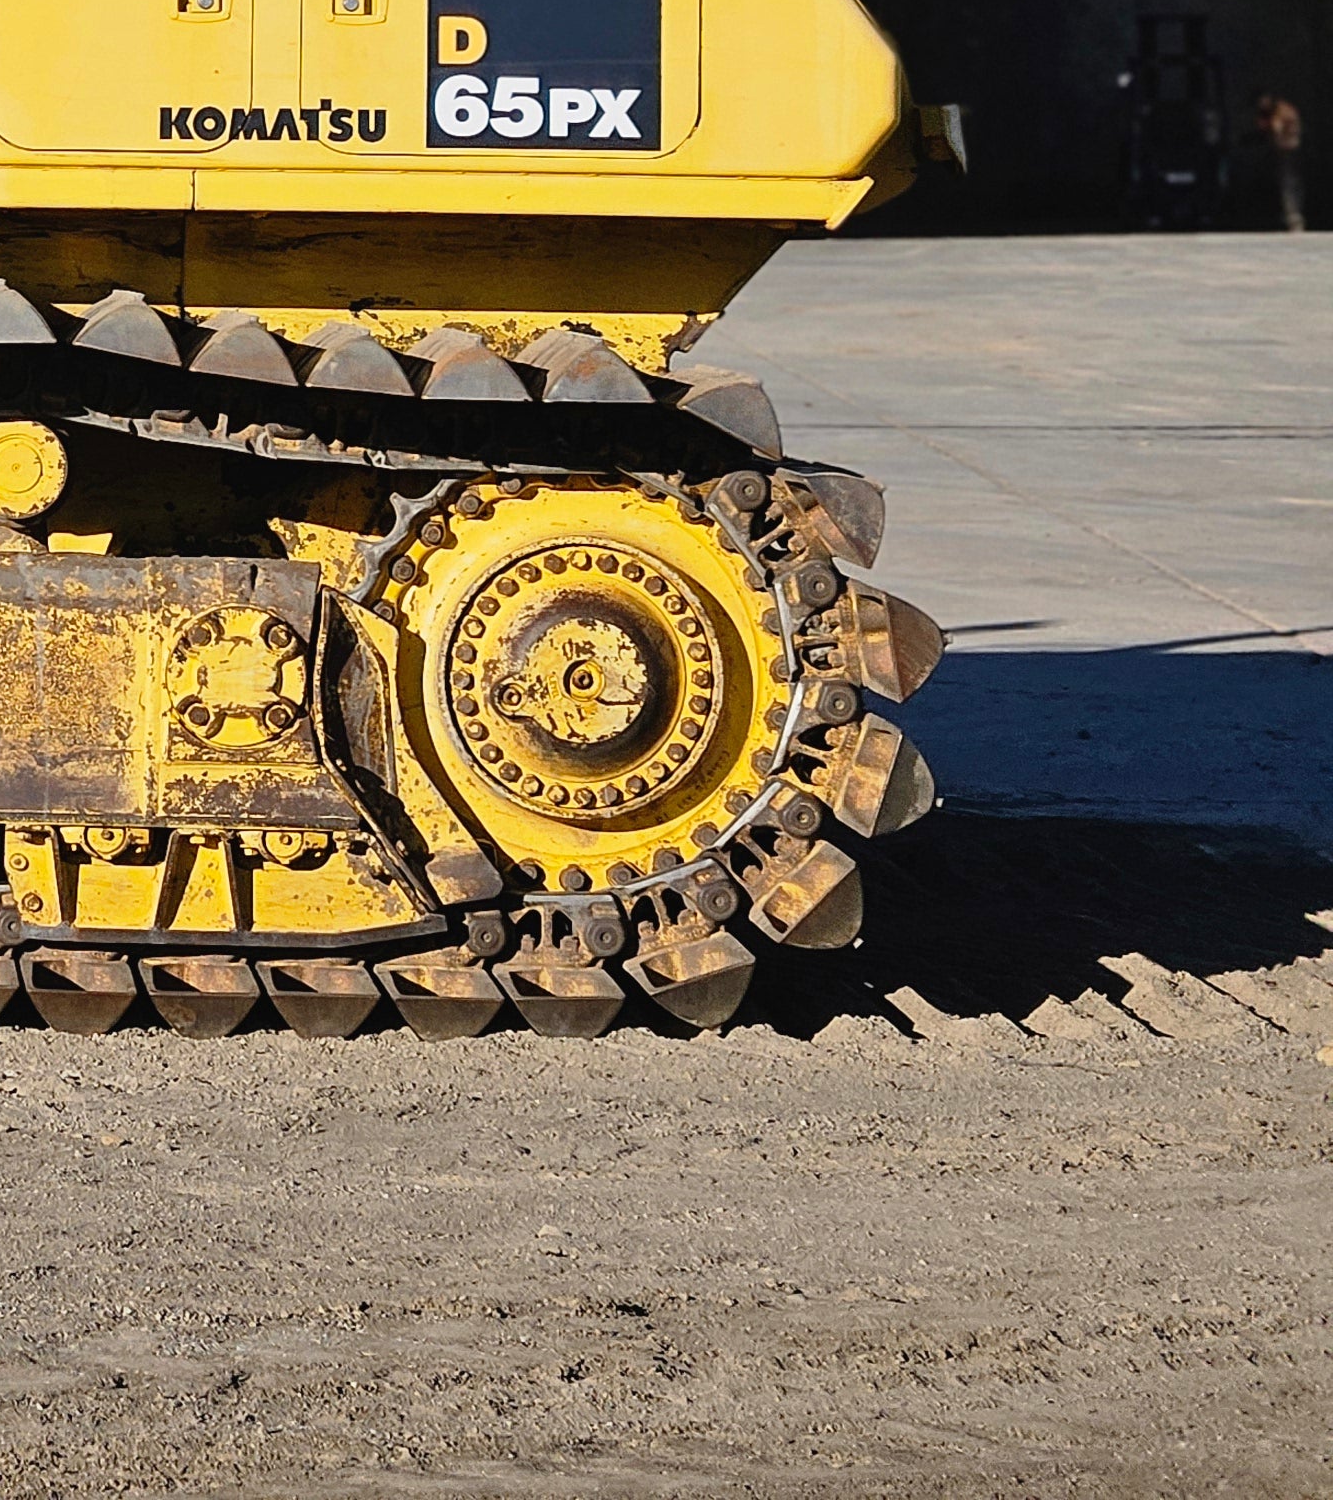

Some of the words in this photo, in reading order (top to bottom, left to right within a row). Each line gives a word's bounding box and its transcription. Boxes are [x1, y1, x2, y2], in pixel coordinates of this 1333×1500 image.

[437, 14, 488, 65] D
[159, 99, 386, 142] KOMATSU
[434, 73, 642, 139] 65PX
